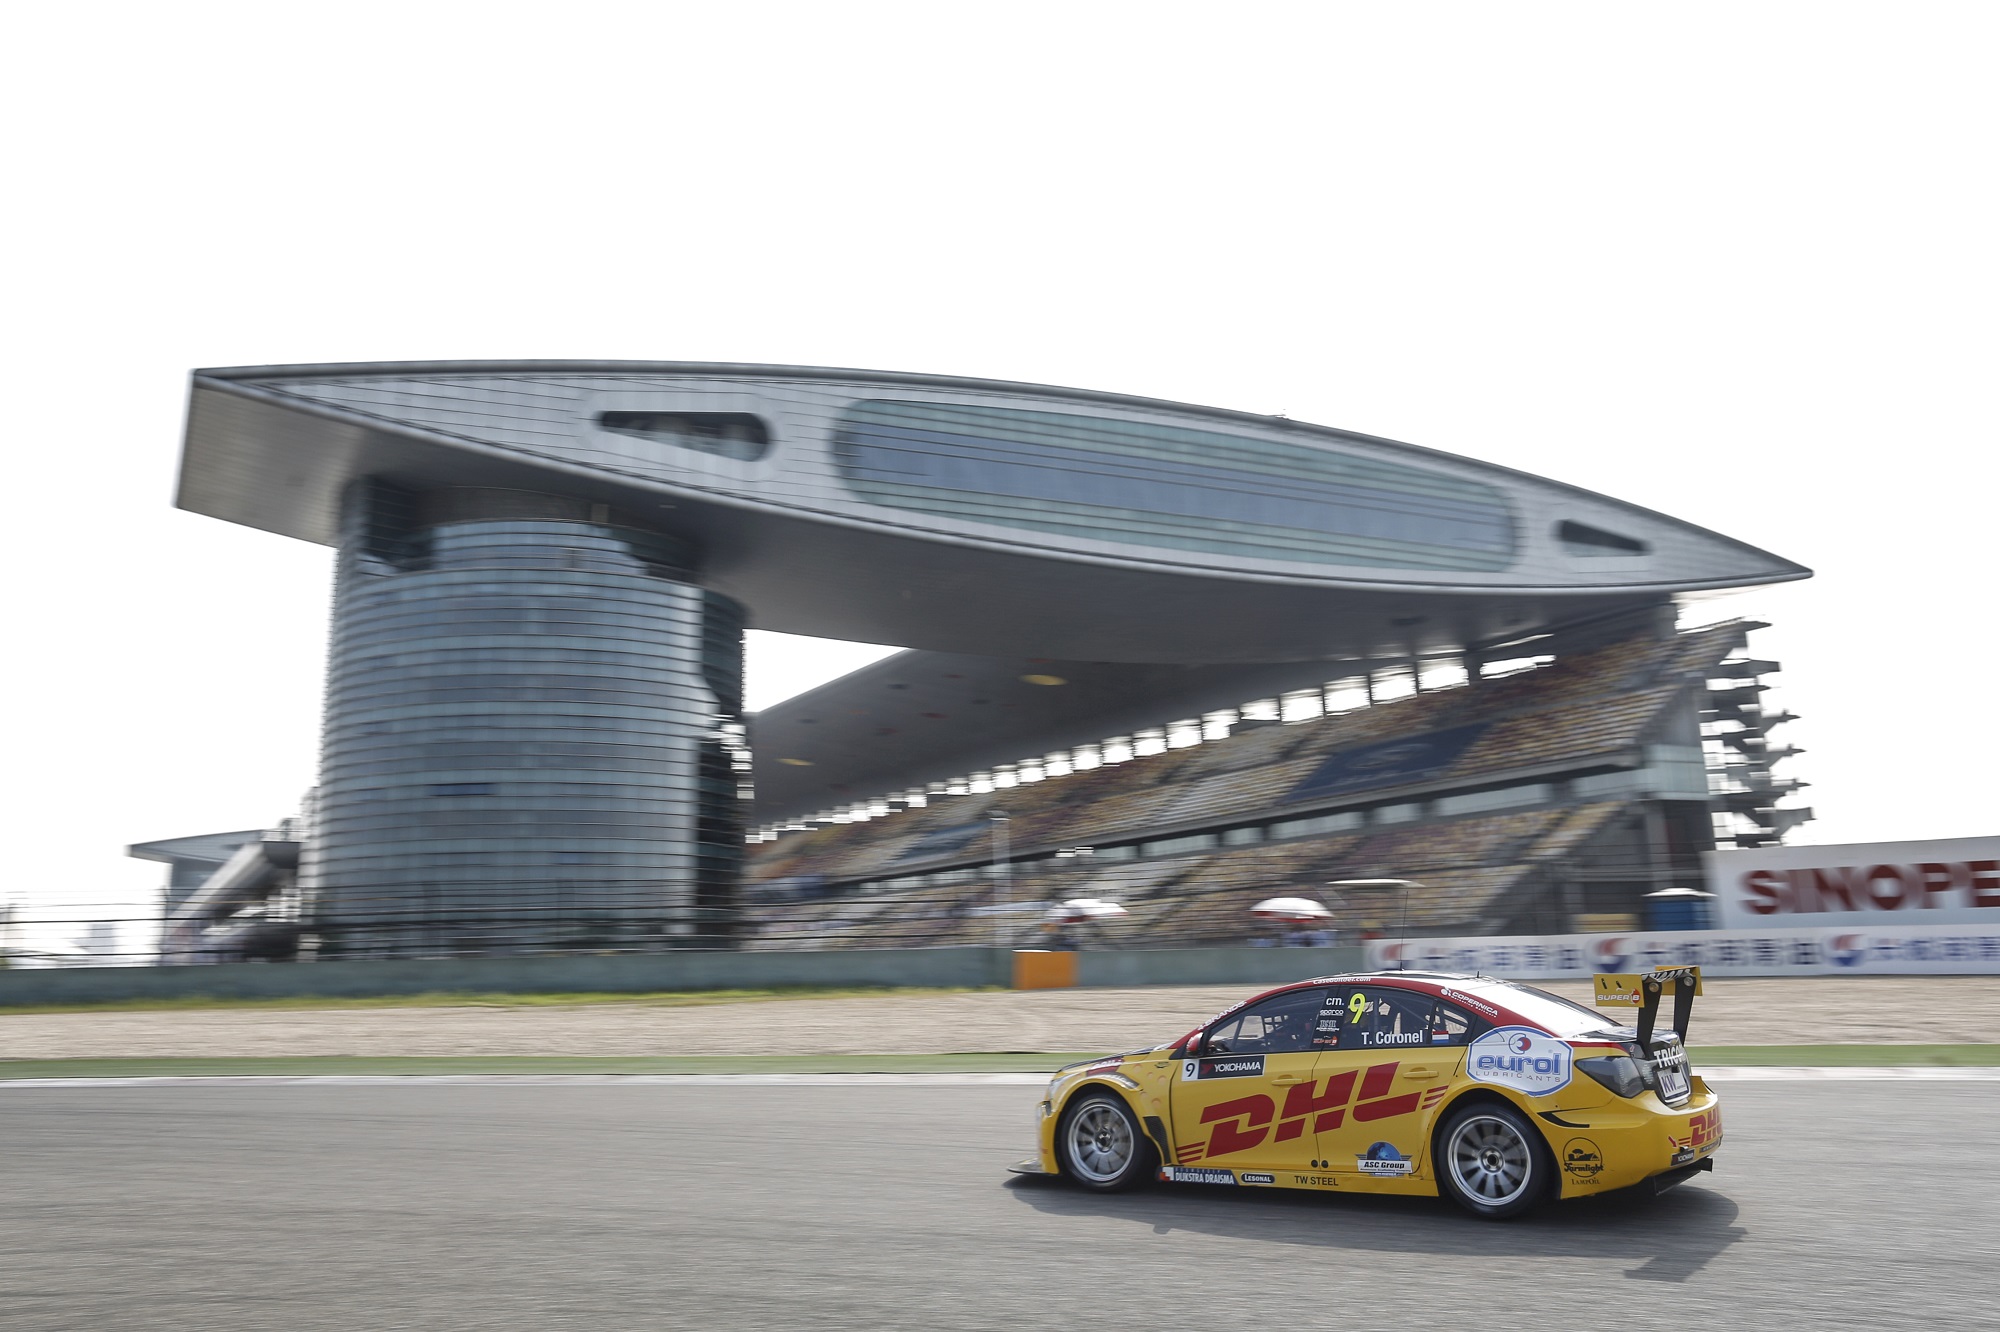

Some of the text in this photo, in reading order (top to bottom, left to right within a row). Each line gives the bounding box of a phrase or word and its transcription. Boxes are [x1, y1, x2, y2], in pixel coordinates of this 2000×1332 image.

[1349, 993, 1366, 1024] 9
[1451, 991, 1498, 1015] COPERNICA
[1319, 1009, 1345, 1017] sparco
[1361, 1030, 1423, 1045] T. Coronel
[1185, 1061, 1261, 1077] 9 YOKOHAMA
[1476, 1053, 1562, 1076] eurol
[1475, 1070, 1561, 1083] LUBRICANTS
[1661, 1074, 1677, 1093] KW
[1200, 1062, 1421, 1158] DHL
[1364, 1161, 1380, 1169] ASC
[1381, 1162, 1405, 1170] Group
[1204, 1174, 1235, 1185] DRAISMA
[1294, 1175, 1339, 1186] TW STEEL
